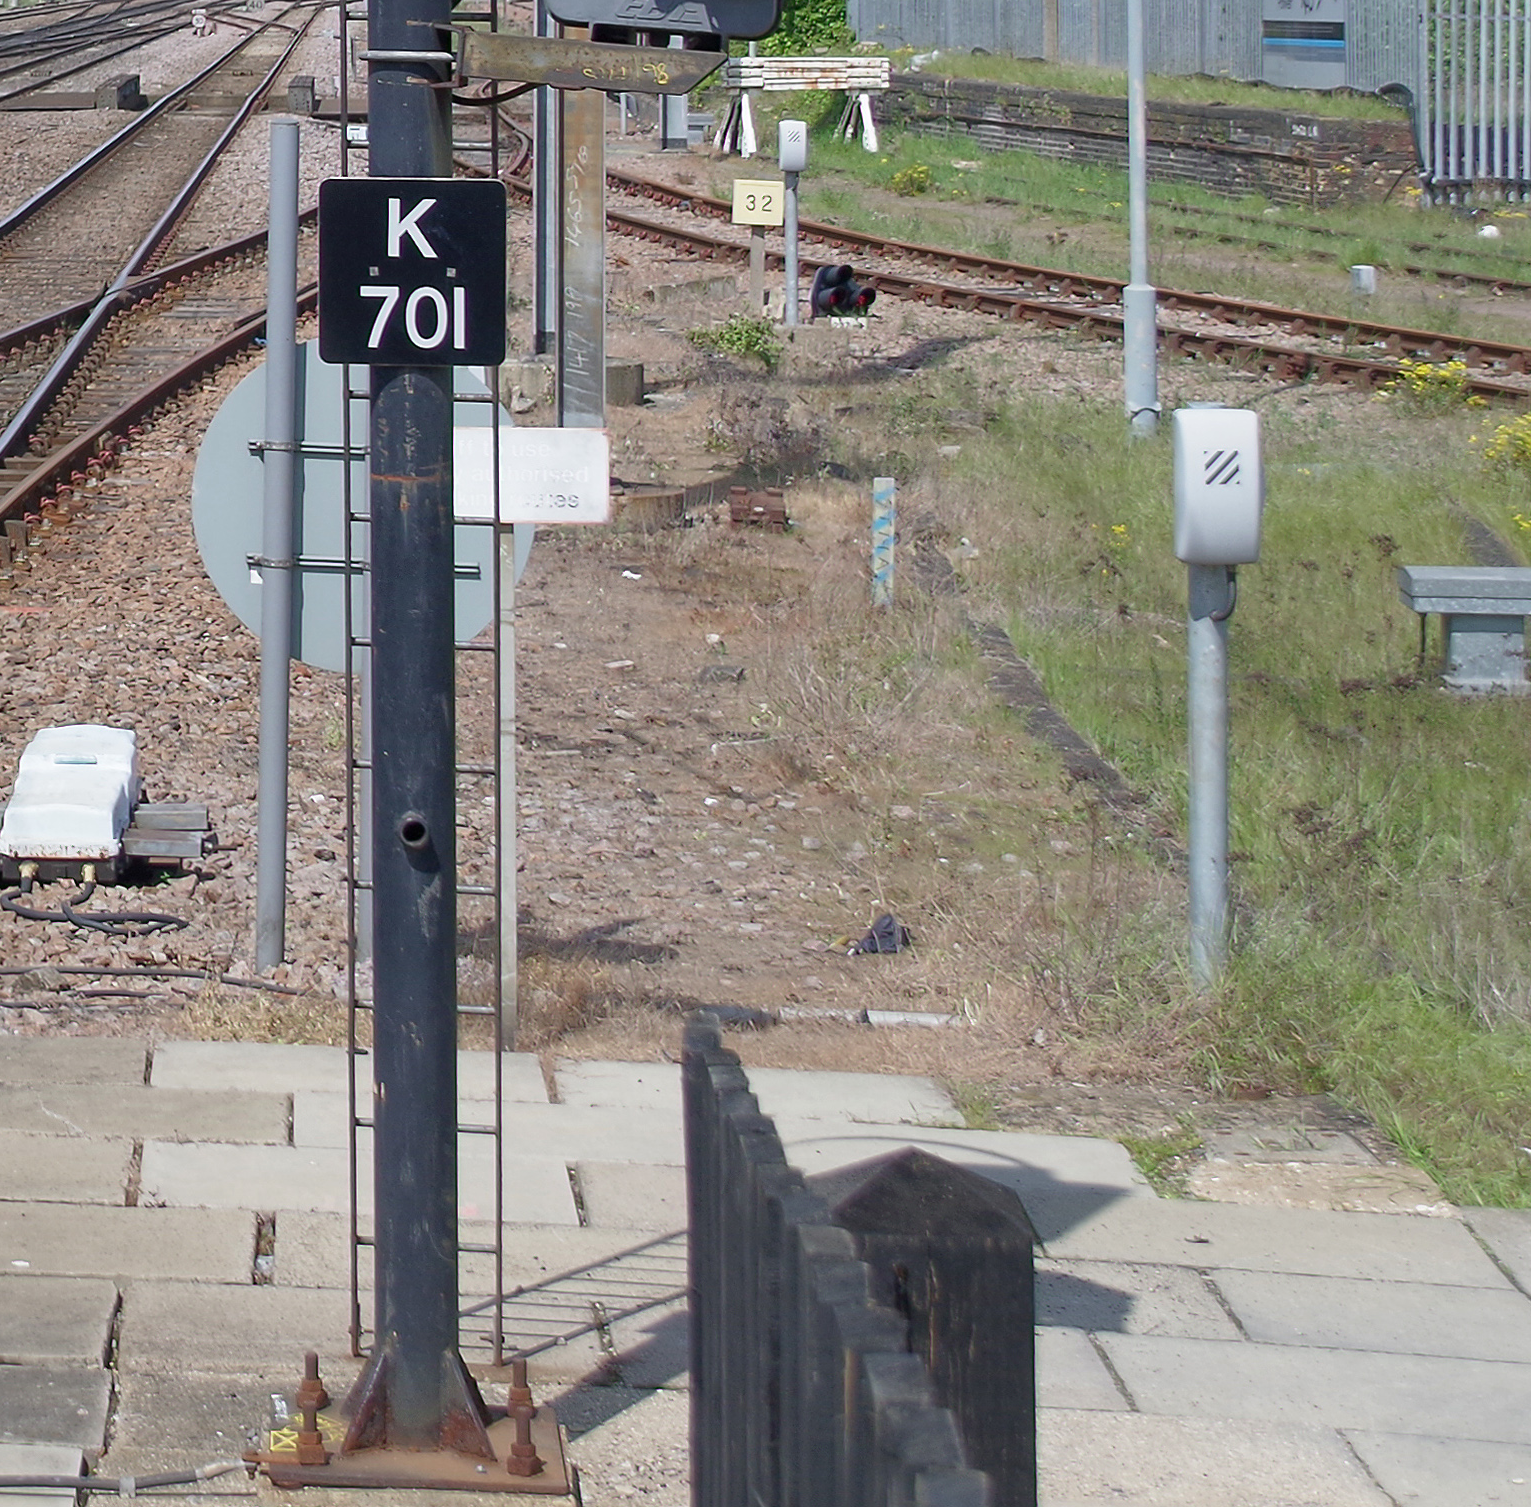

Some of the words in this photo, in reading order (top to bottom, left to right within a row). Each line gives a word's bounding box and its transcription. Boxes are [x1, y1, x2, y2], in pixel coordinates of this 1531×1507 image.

[386, 197, 438, 259] K
[745, 194, 773, 212] 32
[359, 285, 467, 350] 701
